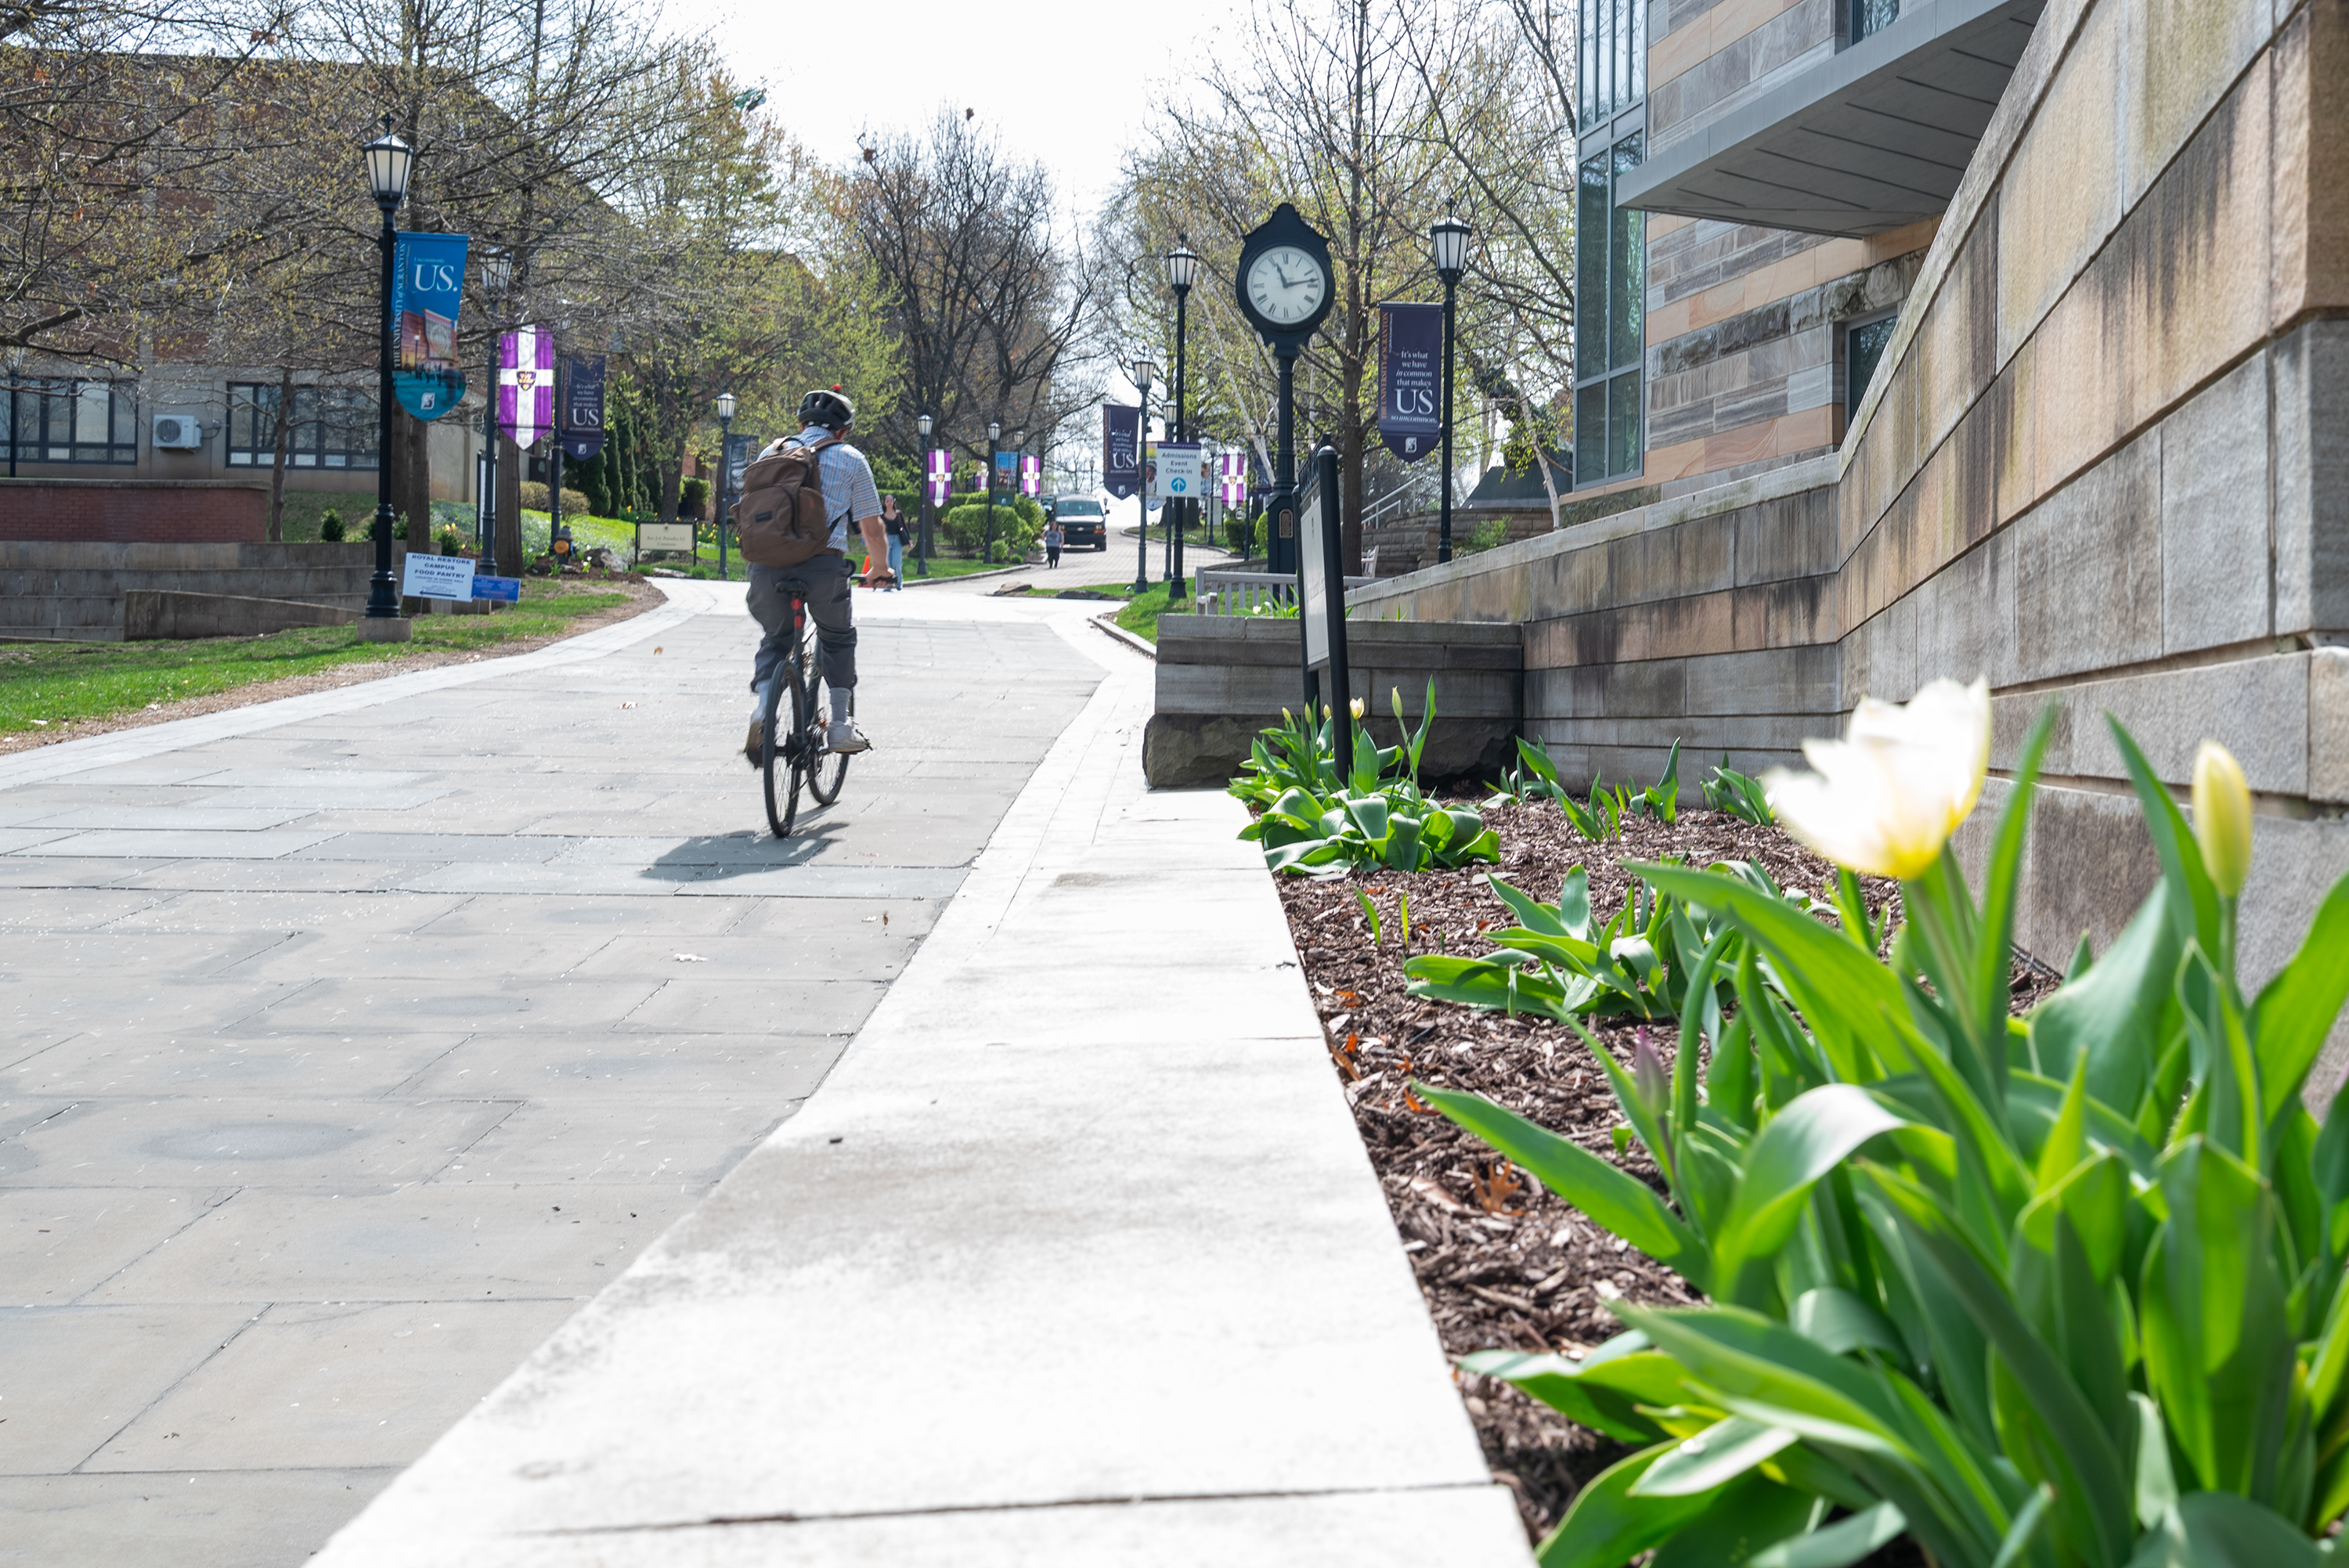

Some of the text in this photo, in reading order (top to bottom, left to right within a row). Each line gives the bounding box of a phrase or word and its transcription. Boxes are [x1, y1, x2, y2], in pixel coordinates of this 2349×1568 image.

[397, 242, 406, 290] SCRANTON
[413, 263, 458, 292] US.
[1401, 350, 1428, 359] It's what
[1397, 378, 1410, 387] that
[1394, 388, 1433, 415] US
[572, 408, 599, 427] US
[1113, 452, 1135, 469] US
[437, 557, 471, 565] RESTORE
